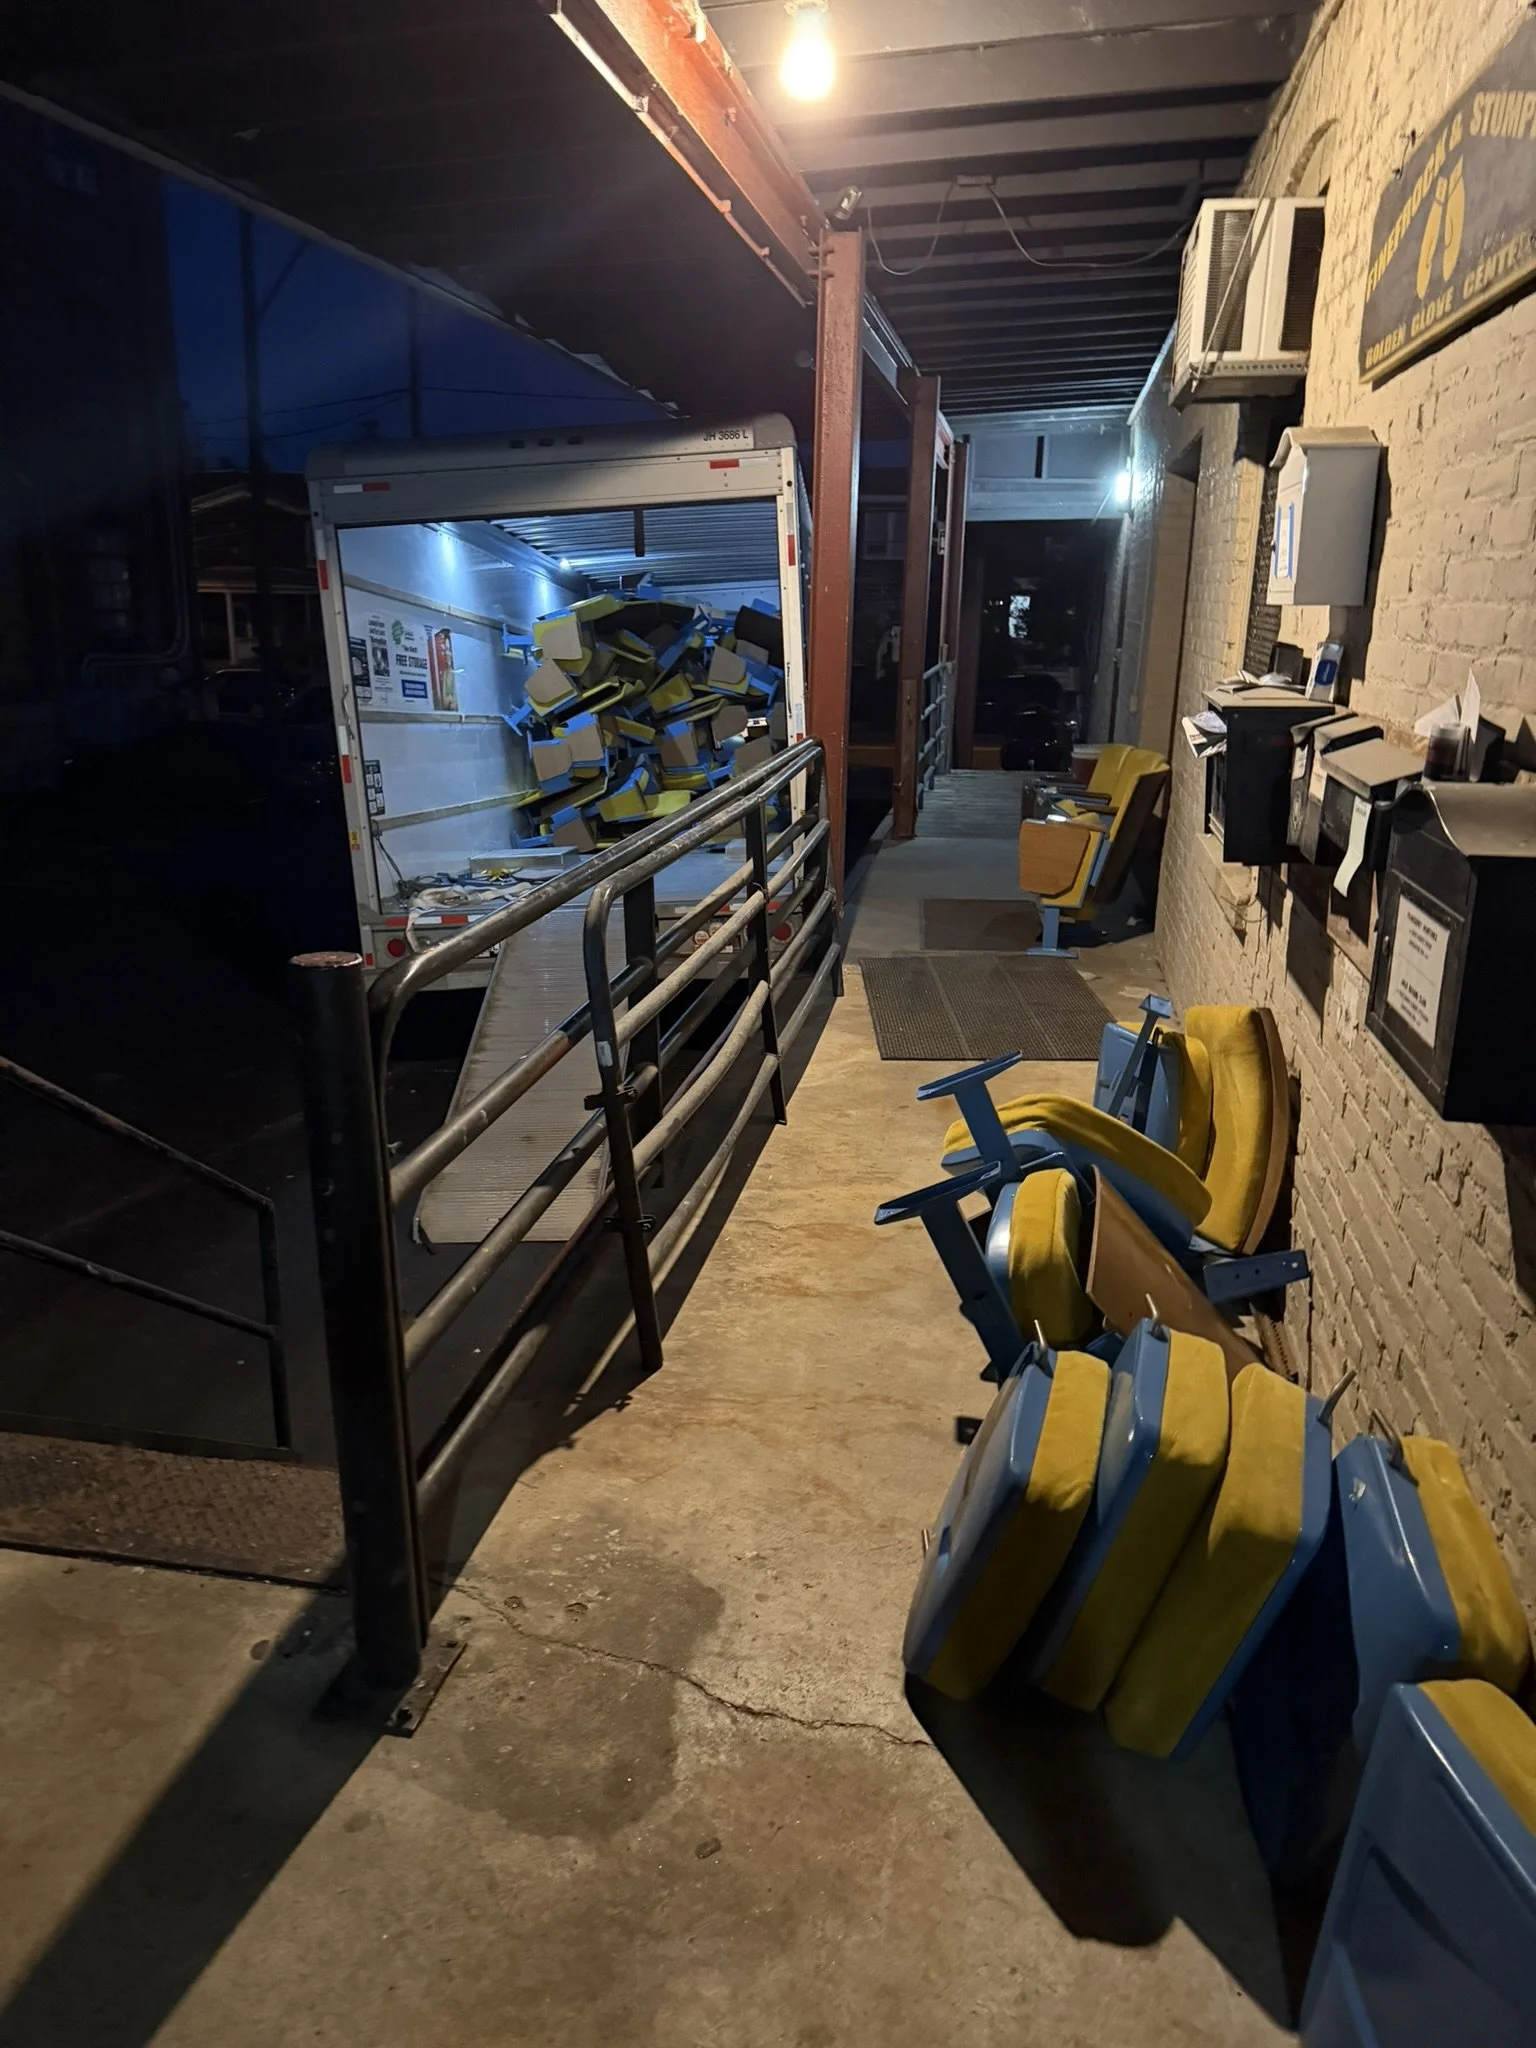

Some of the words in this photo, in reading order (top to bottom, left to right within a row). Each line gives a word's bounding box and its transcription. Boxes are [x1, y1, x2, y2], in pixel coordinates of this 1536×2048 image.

[1365, 322, 1406, 369] GOLDEN
[1411, 285, 1454, 337] GLOVE
[703, 431, 716, 441] JH
[742, 429, 749, 439] L
